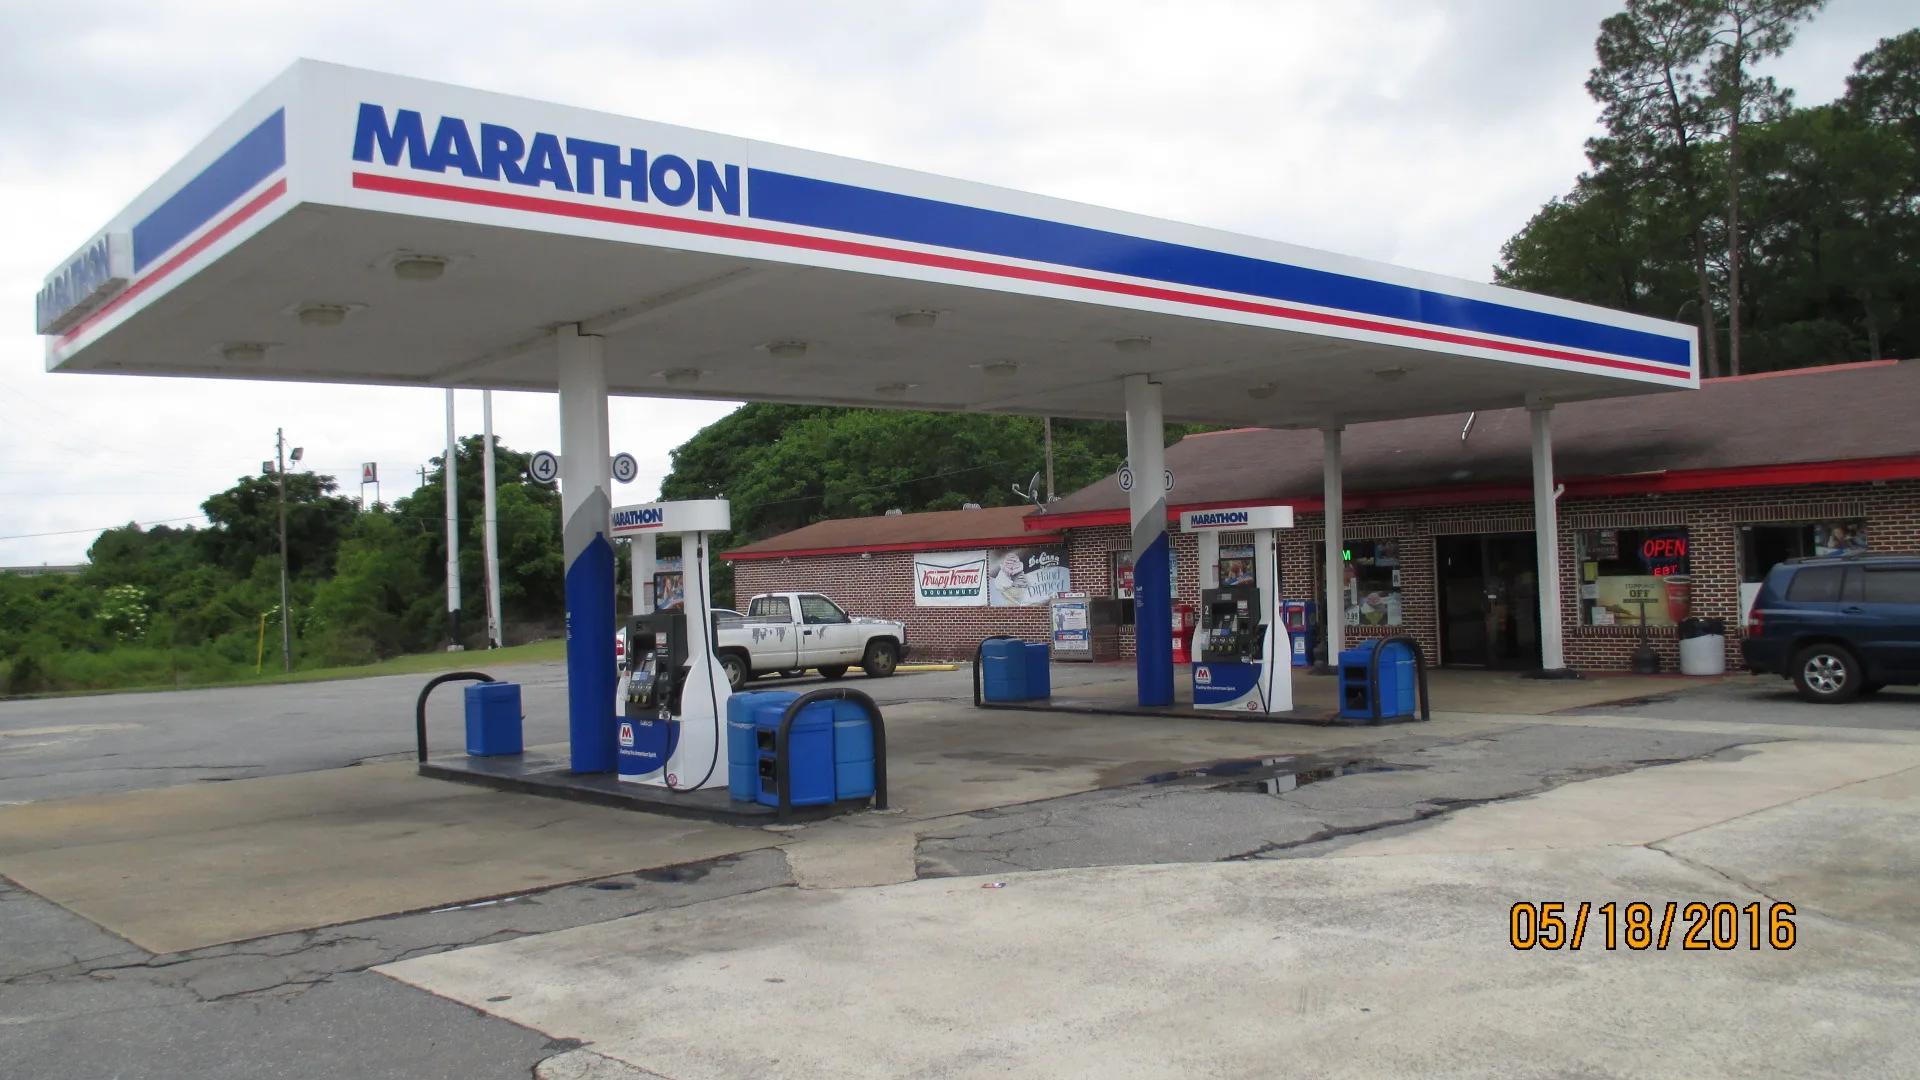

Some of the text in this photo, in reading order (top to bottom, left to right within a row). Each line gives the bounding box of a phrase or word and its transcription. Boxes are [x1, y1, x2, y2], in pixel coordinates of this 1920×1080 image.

[352, 102, 741, 217] MARATHON
[539, 459, 551, 475] 4
[619, 460, 630, 476] 3
[1123, 473, 1129, 486] 2
[1191, 511, 1248, 525] MARATHON
[1644, 539, 1687, 558] OPEN
[1036, 567, 1061, 582] Hand
[1654, 564, 1677, 576] EBT
[922, 569, 980, 589] Krispy Kreme
[1026, 579, 1065, 598] Dipped
[1204, 605, 1209, 615] 2
